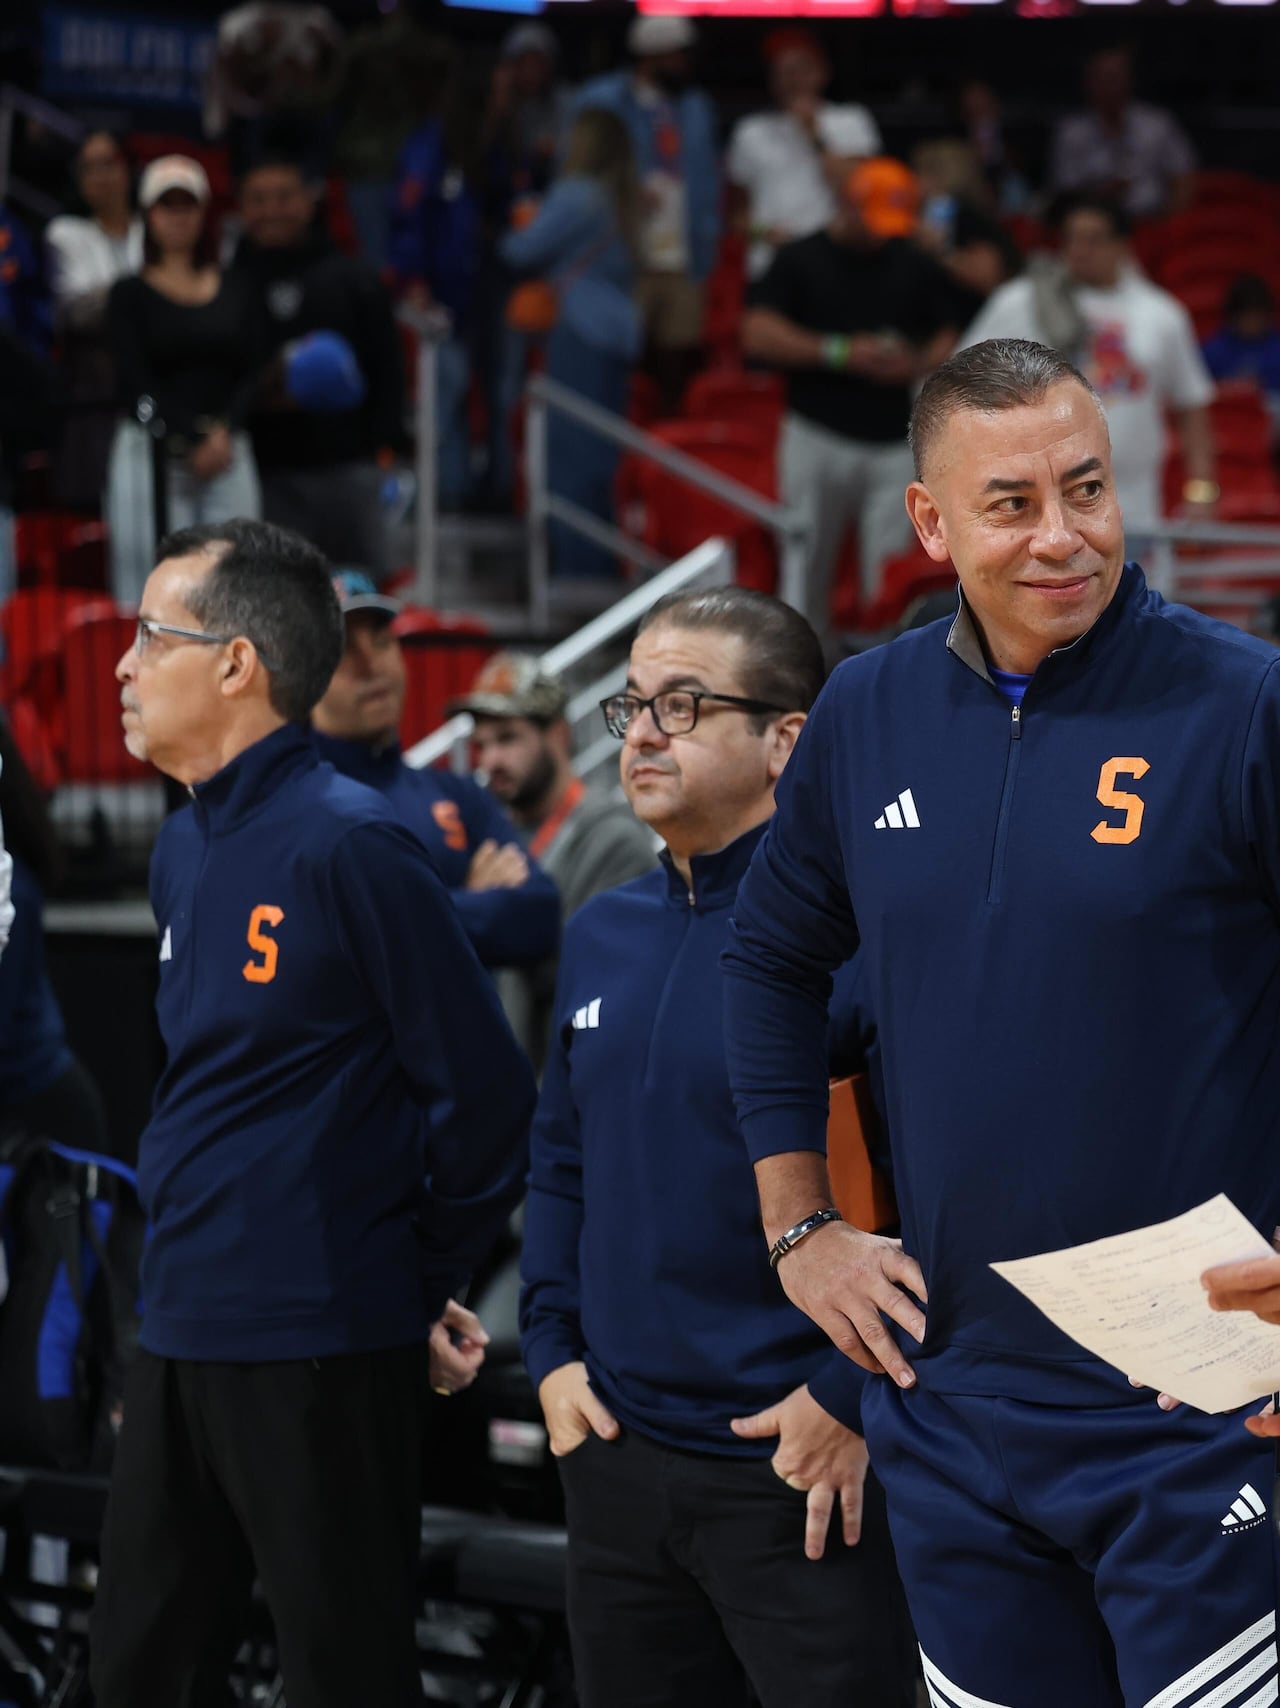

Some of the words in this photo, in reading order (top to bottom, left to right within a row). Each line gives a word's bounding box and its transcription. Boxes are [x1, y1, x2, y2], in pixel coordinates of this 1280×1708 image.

[431, 800, 468, 852] S
[1089, 756, 1151, 845] S
[242, 904, 284, 984] S
